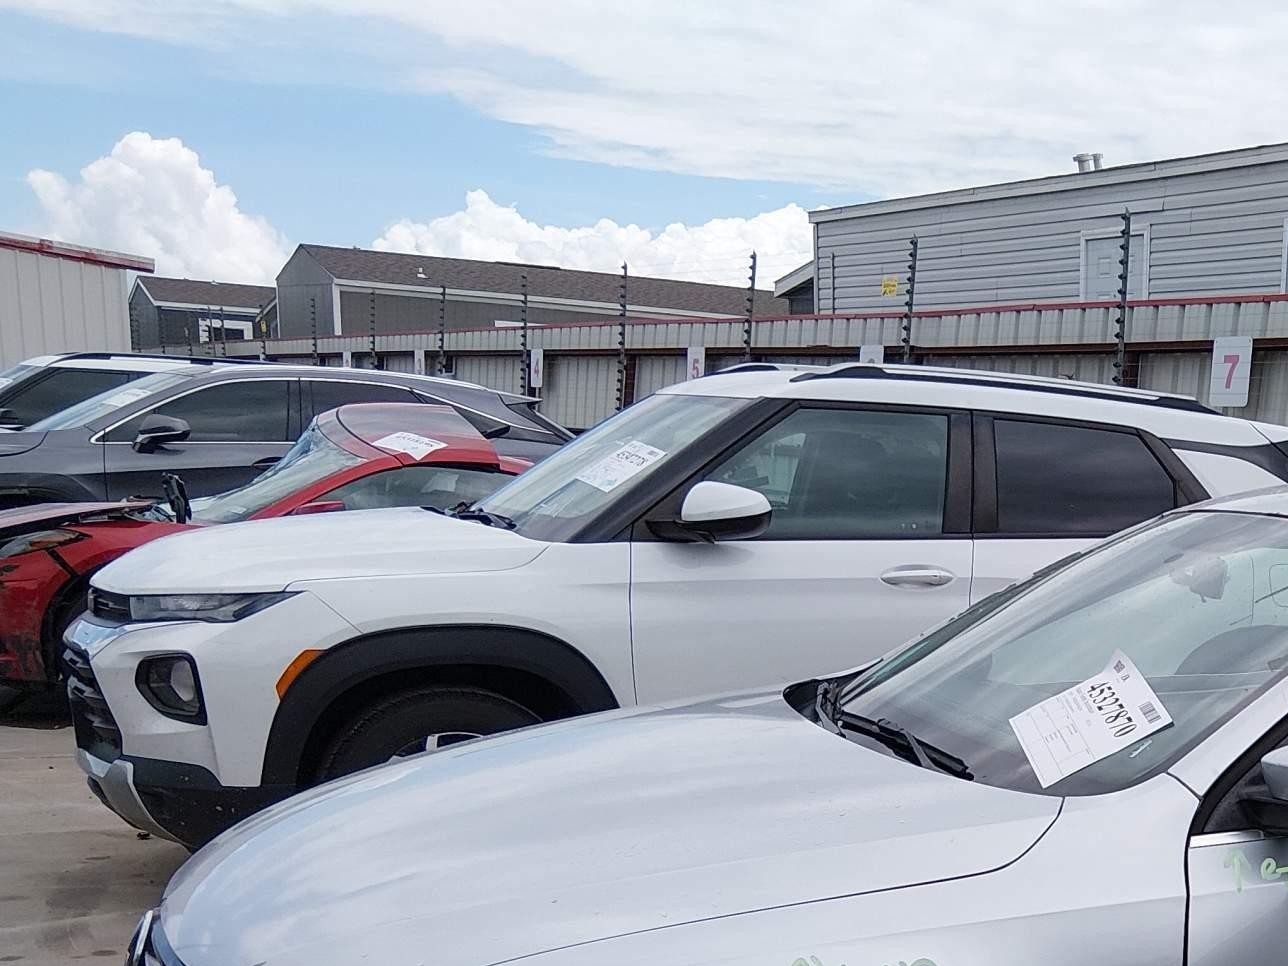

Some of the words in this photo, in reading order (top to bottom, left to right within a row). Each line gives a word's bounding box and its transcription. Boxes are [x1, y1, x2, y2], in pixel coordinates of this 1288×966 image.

[533, 358, 540, 378] 4
[692, 358, 700, 380] 5
[1224, 354, 1240, 389] 7
[1087, 681, 1137, 738] 45327870
